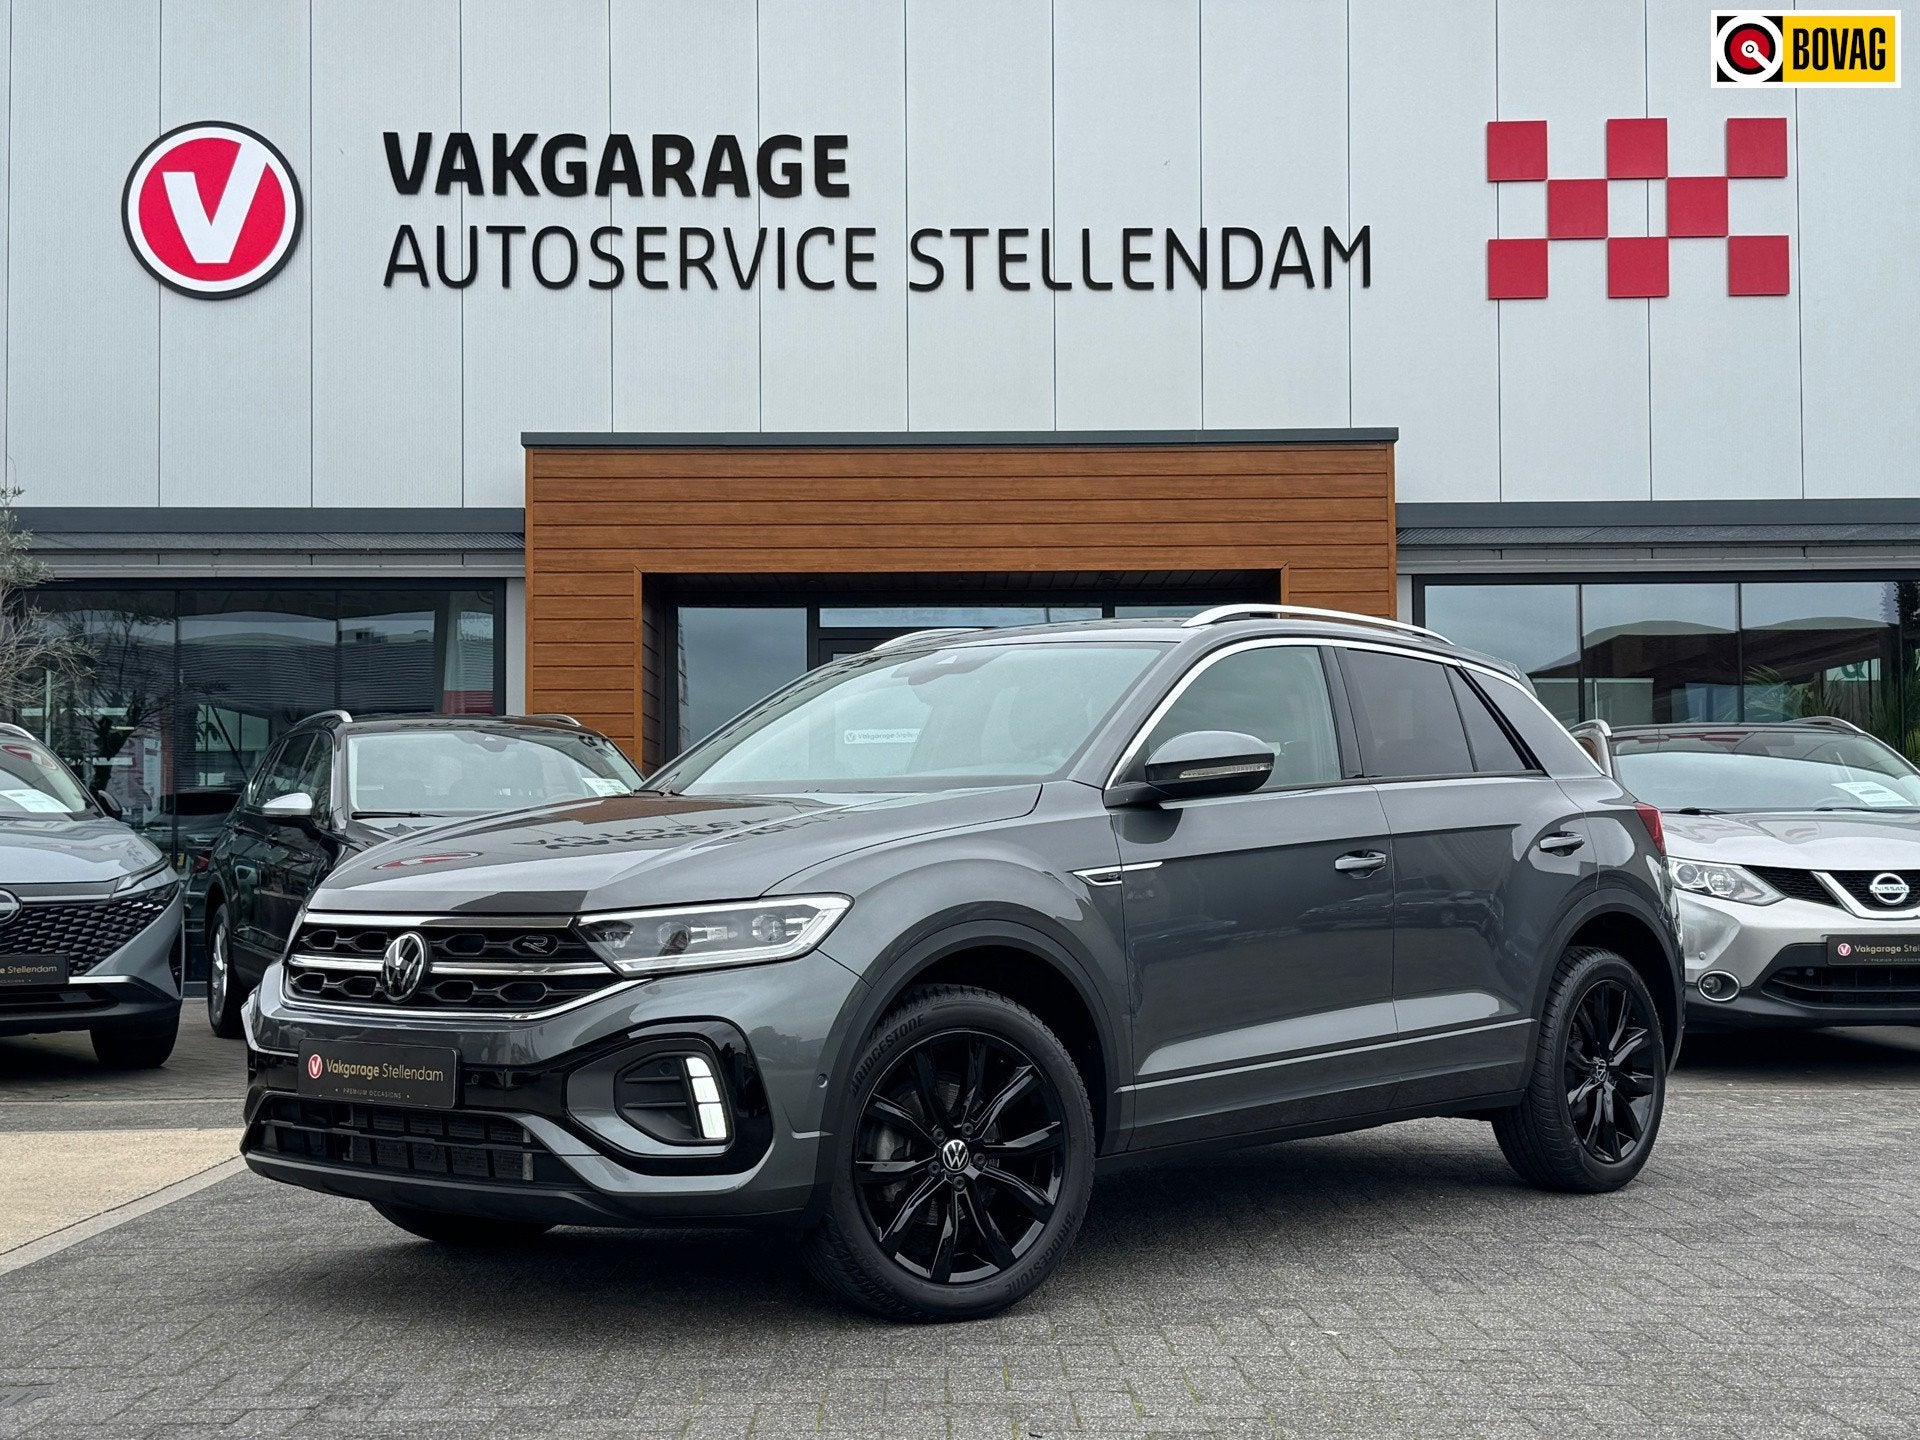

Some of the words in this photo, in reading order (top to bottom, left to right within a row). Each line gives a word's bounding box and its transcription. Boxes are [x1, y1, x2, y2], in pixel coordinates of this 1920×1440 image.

[383, 132, 850, 198] VAKGARAGE
[384, 225, 878, 292] AUTOSERVICE
[909, 225, 1370, 293] STELLENDAM
[1854, 945, 1901, 954] Vakgarage
[326, 1059, 380, 1080] Vakgarage
[382, 1063, 444, 1082] Stellendam
[343, 1087, 368, 1096] PREMIUM
[369, 1089, 402, 1099] OCCASIONS
